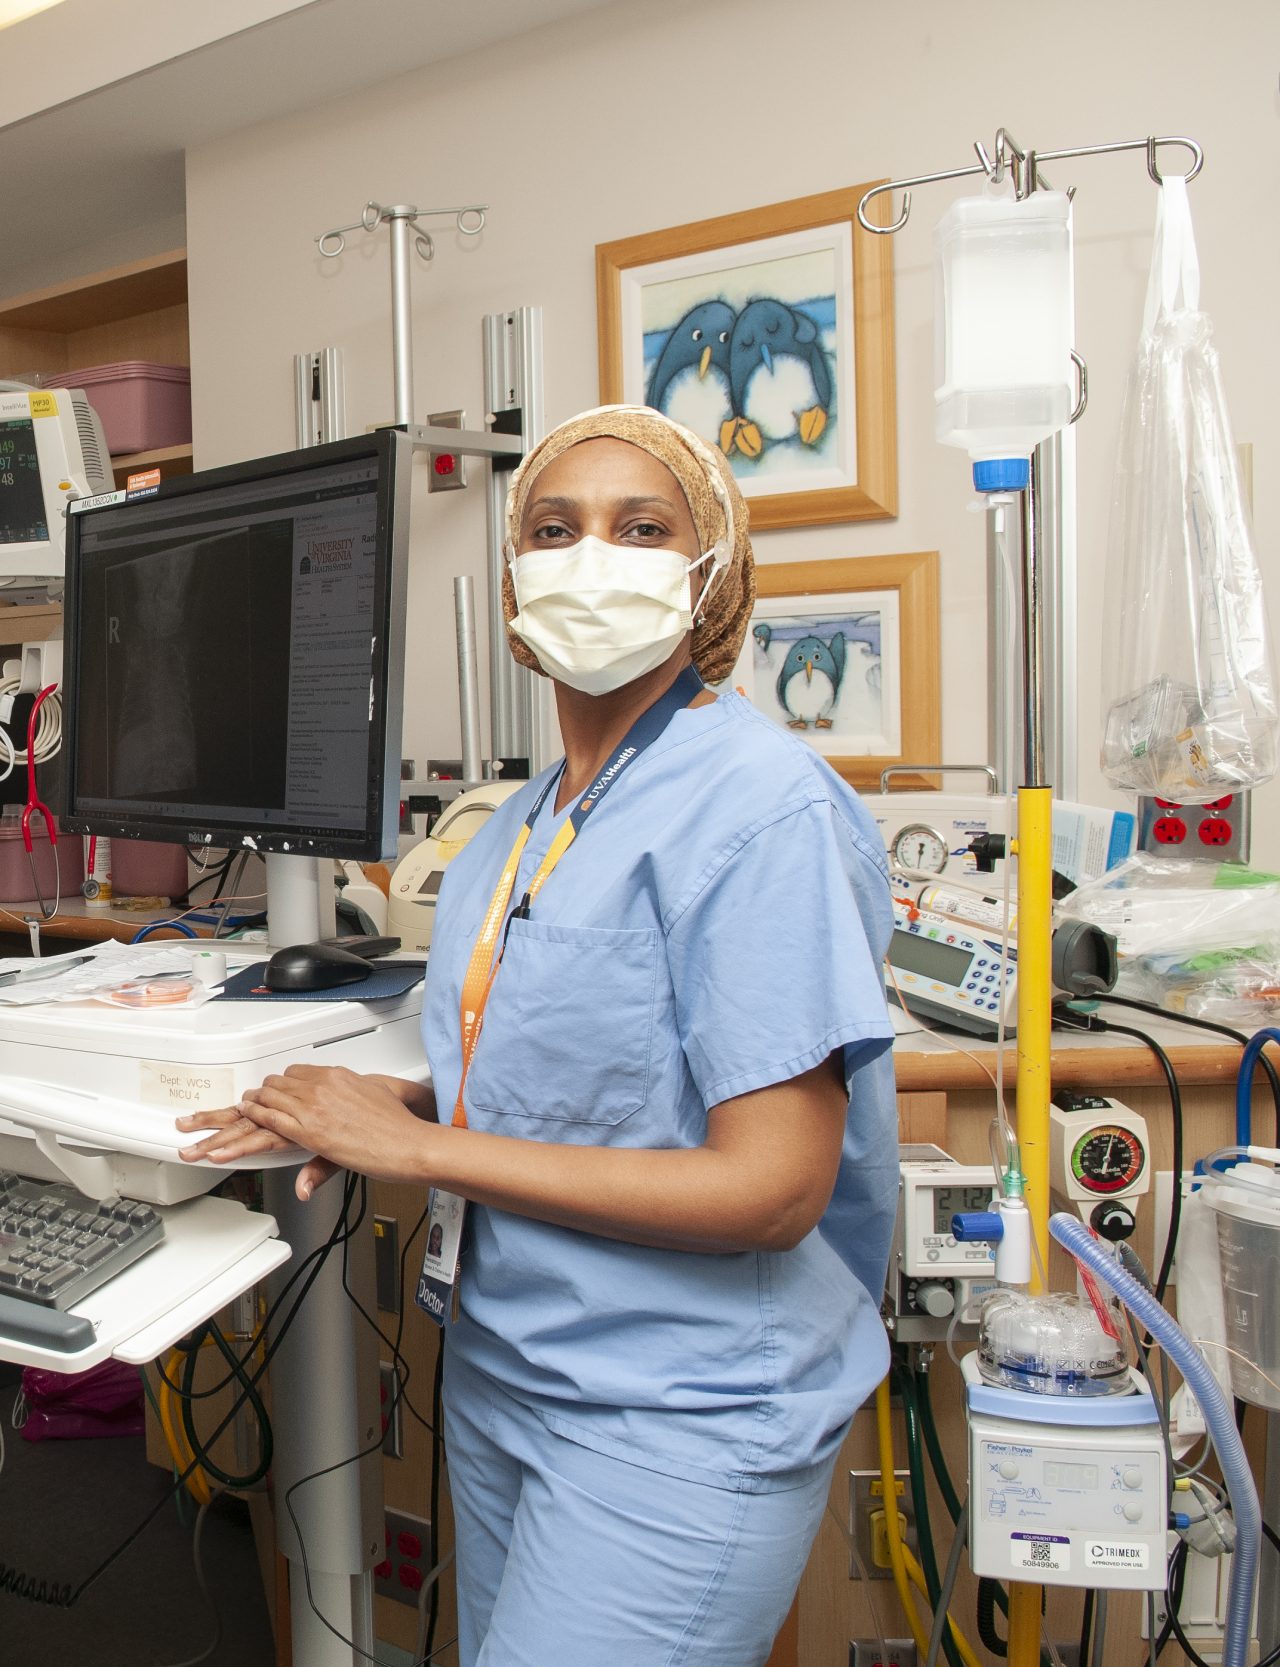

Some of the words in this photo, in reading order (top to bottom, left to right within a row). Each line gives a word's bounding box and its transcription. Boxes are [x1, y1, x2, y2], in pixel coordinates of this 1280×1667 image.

[32, 399, 50, 407] MP30
[0, 456, 11, 470] 97
[1, 472, 14, 487] 48
[306, 538, 353, 555] UNIVERSITY
[316, 550, 352, 565] VIRGINIA
[108, 616, 120, 644] R
[588, 746, 637, 800] UVAHealth
[186, 1078, 211, 1089] WCS
[169, 1087, 192, 1100] NICU
[194, 1091, 200, 1100] 4
[419, 1279, 444, 1315] Doctor
[987, 1443, 1007, 1451] Fisher
[1012, 1446, 1033, 1454] Paykel
[1023, 1534, 1052, 1542] EQUIPMENT
[1105, 1547, 1140, 1558] TRIMEDX
[1022, 1559, 1060, 1570] 50849906
